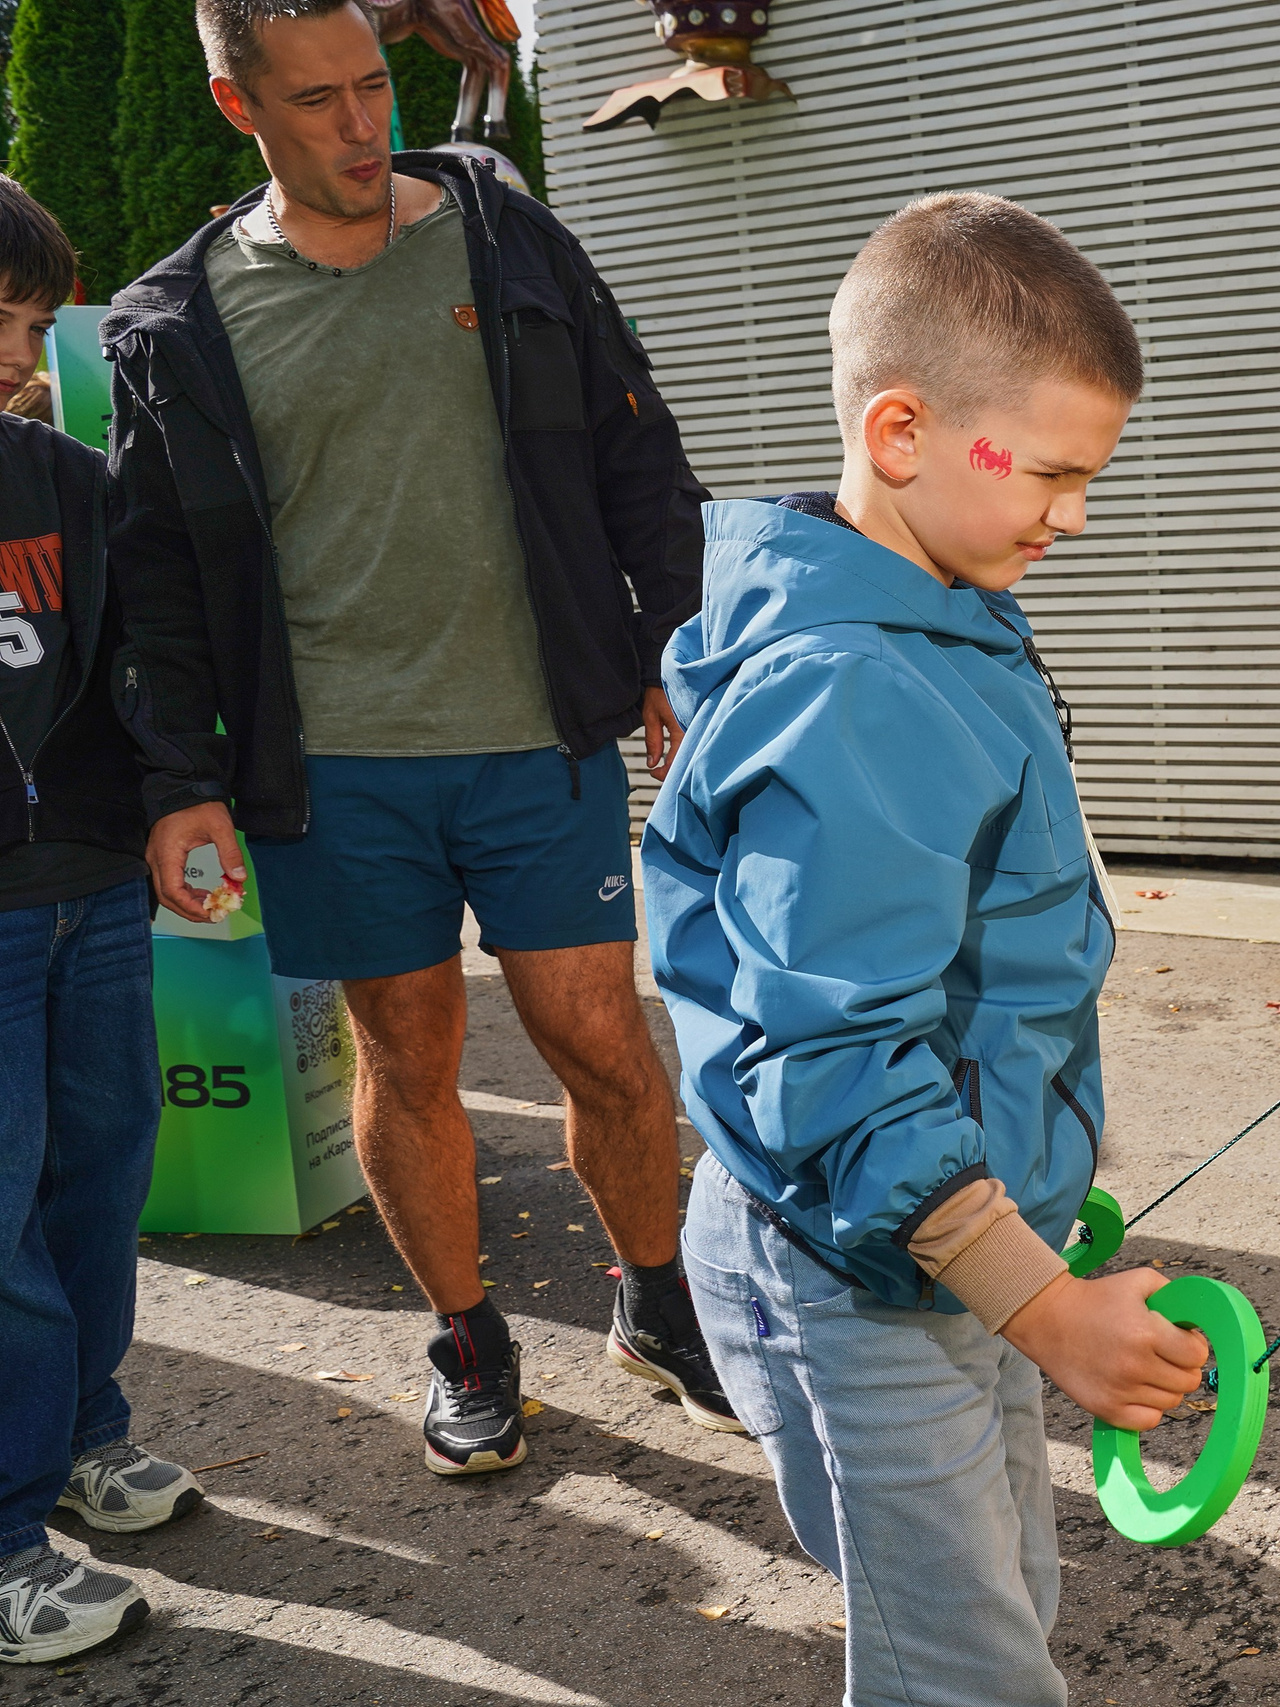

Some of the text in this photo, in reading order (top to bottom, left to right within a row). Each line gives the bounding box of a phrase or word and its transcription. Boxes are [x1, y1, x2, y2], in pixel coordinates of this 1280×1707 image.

[604, 875, 625, 888] NIKE
[160, 1064, 251, 1109] 85
[305, 1079, 342, 1103] ВКонтакте
[309, 1156, 321, 1170] на
